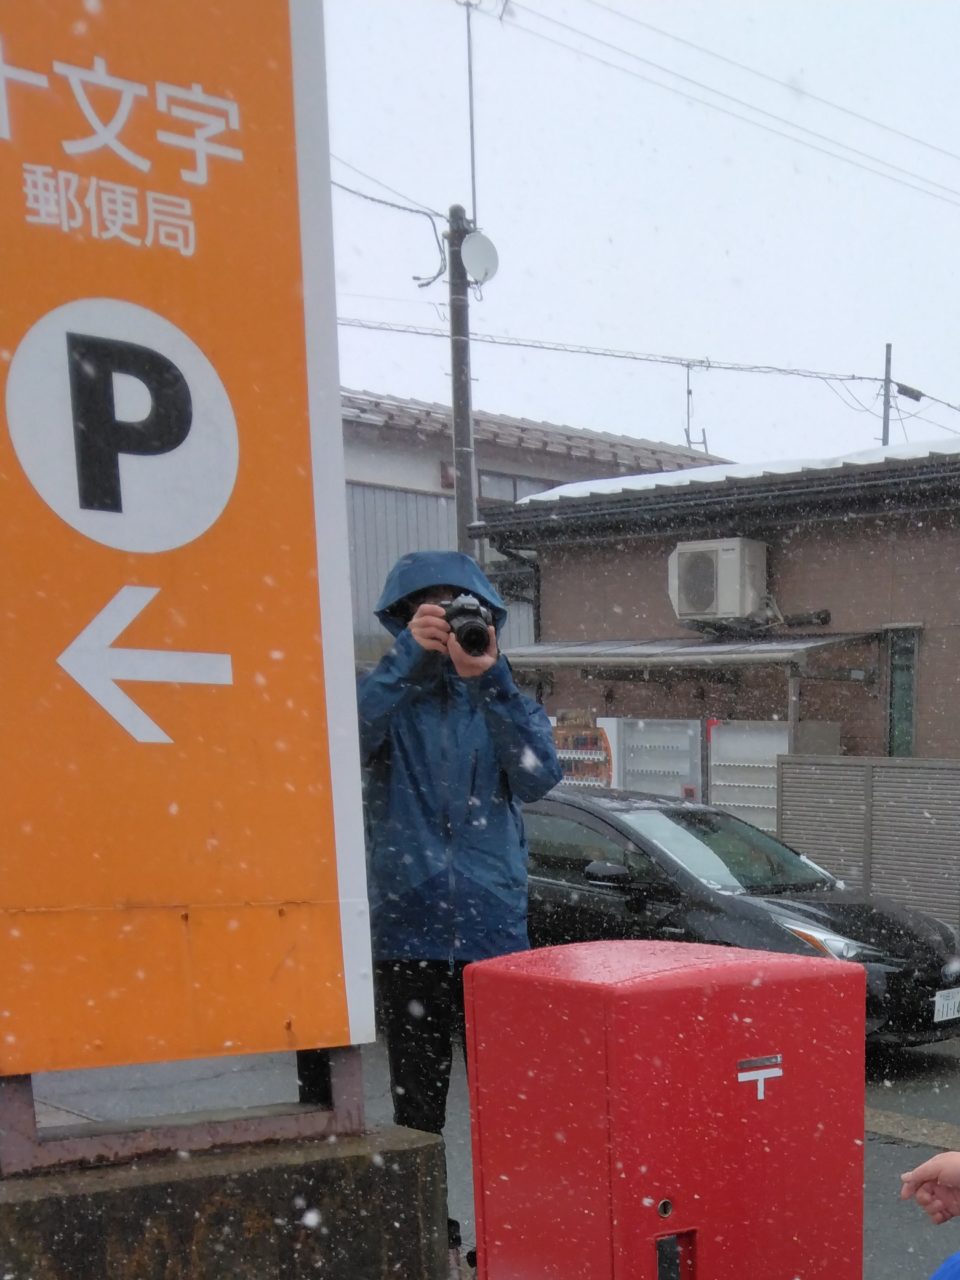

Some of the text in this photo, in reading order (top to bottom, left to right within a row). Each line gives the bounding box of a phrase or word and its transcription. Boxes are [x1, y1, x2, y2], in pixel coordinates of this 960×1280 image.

[22, 162, 196, 257] 郵便局
[66, 331, 193, 513] P
